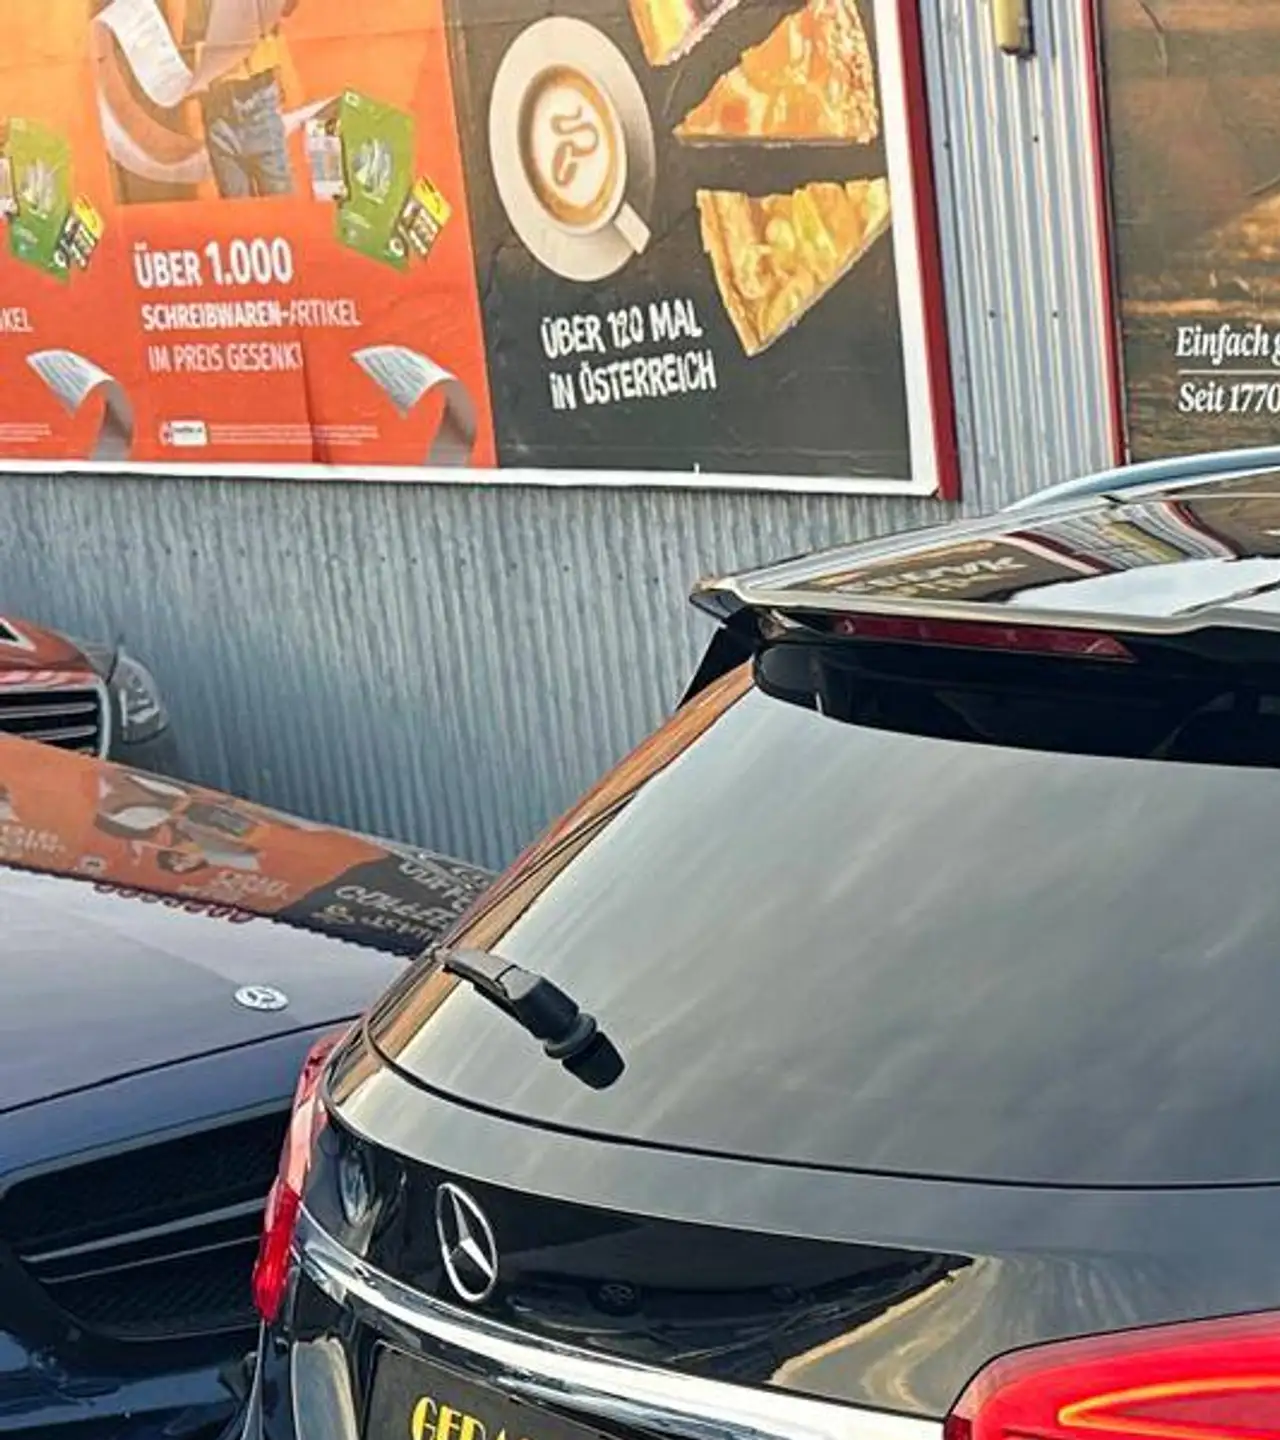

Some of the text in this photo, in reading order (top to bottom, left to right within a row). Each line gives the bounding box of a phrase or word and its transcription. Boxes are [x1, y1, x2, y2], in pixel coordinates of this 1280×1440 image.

[133, 237, 294, 288] ÜBER 1.000
[540, 298, 703, 359] ÜBER 120 MAL
[1175, 323, 1270, 366] Einfach
[148, 345, 171, 372] IM
[173, 343, 223, 372] PREIS
[578, 349, 717, 405] ÖSTERREICH
[1178, 381, 1226, 413] Seit
